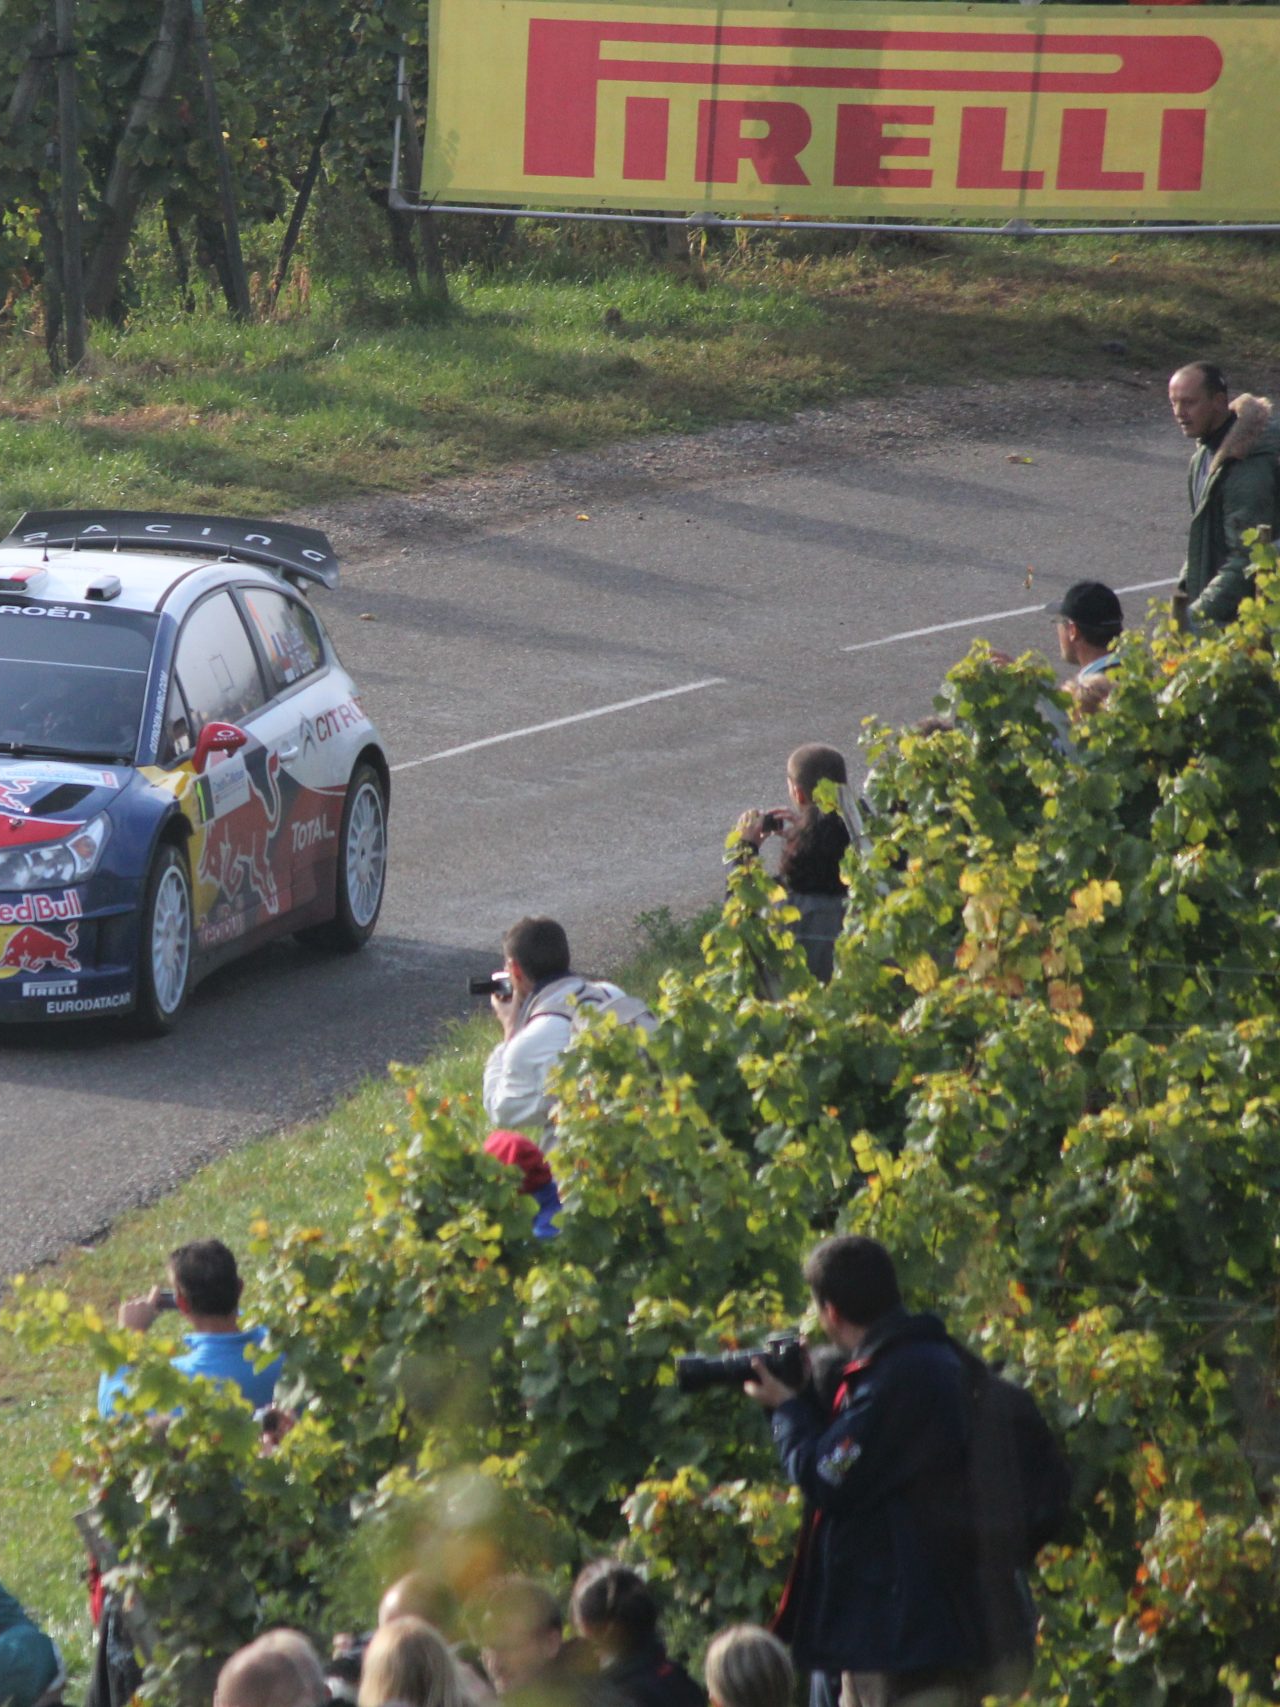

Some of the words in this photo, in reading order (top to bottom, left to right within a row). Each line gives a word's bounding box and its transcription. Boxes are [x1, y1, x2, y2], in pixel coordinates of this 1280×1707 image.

[523, 18, 1224, 192] PIRELLI
[23, 523, 327, 562] RACING
[291, 813, 336, 853] TOTAL
[33, 888, 83, 923] Bull
[22, 980, 78, 997] PIRELLI
[46, 992, 131, 1014] EURODATACAR
